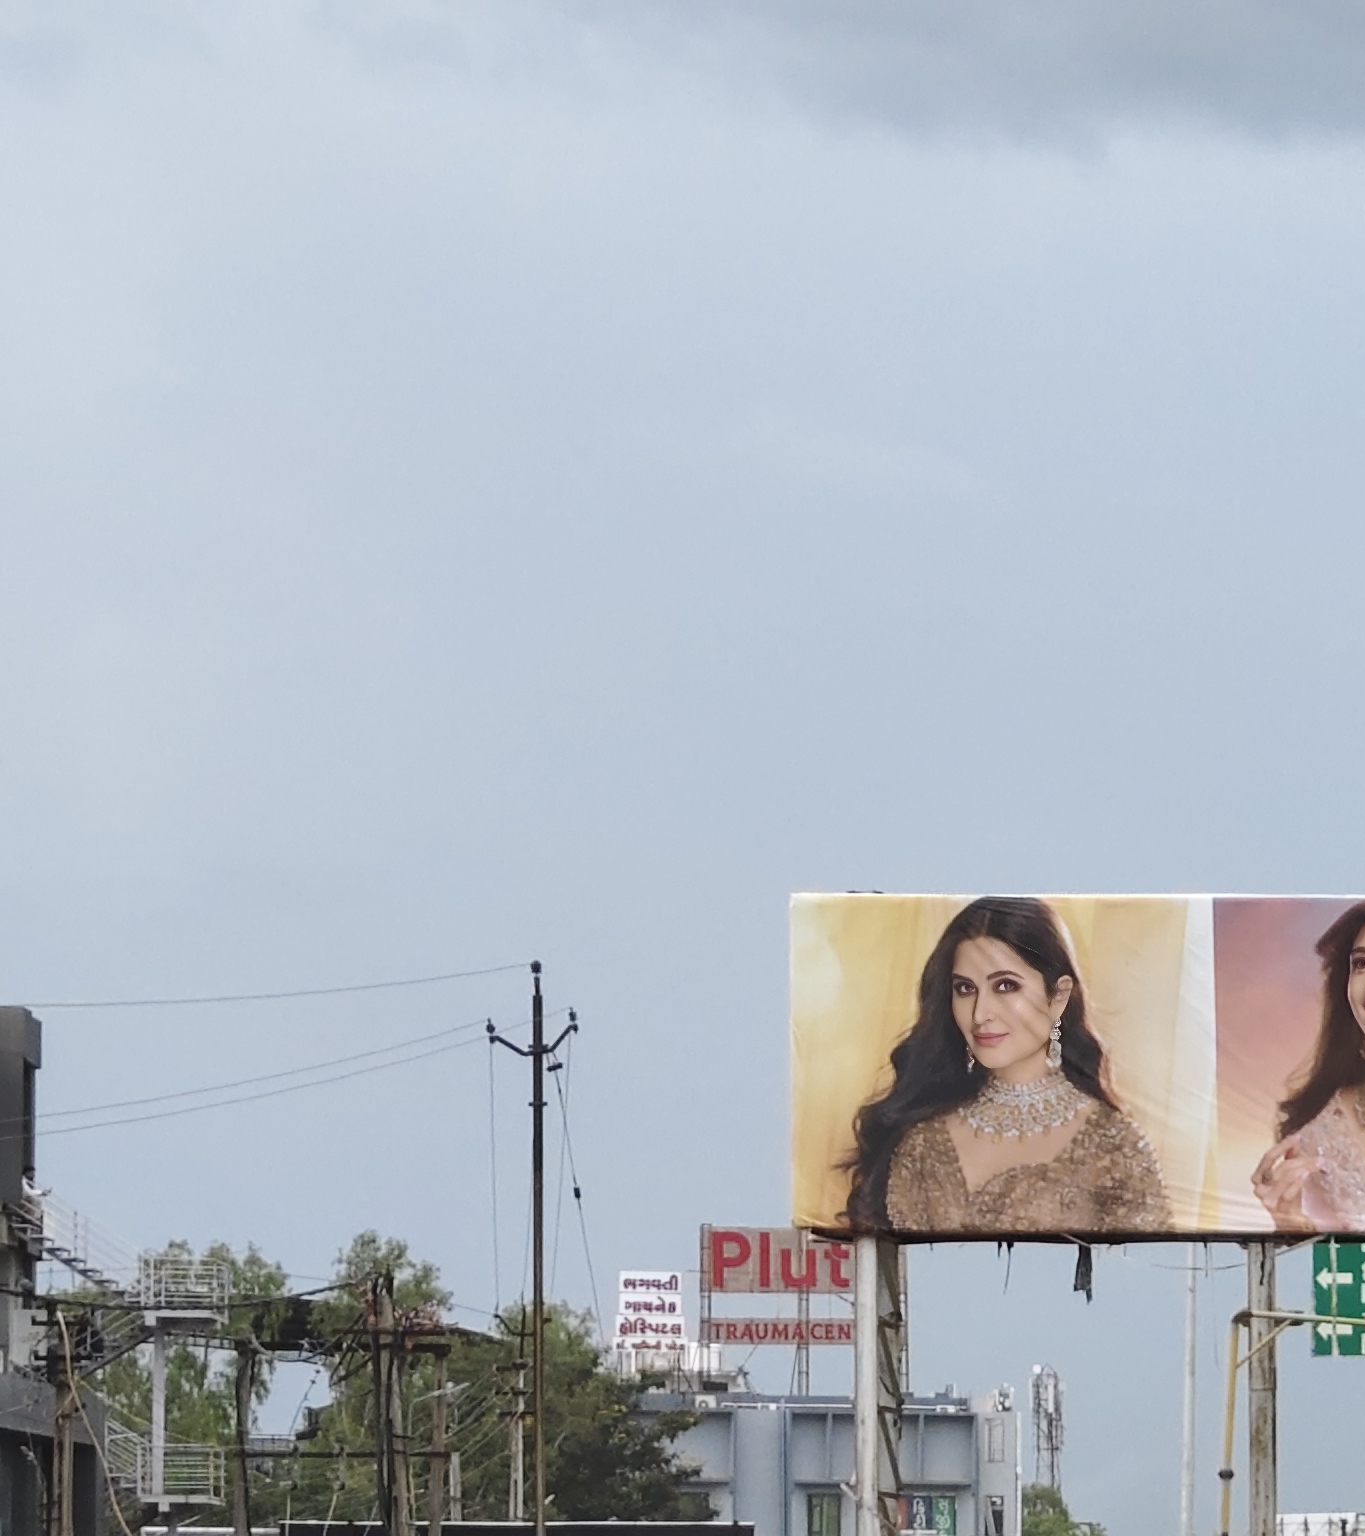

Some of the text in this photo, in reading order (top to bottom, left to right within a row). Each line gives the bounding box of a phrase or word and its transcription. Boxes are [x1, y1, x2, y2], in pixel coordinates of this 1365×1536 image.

[711, 1231, 850, 1289] Plut
[623, 1274, 678, 1291] ભગવતી
[713, 1323, 850, 1340] TRAUMA CEN
